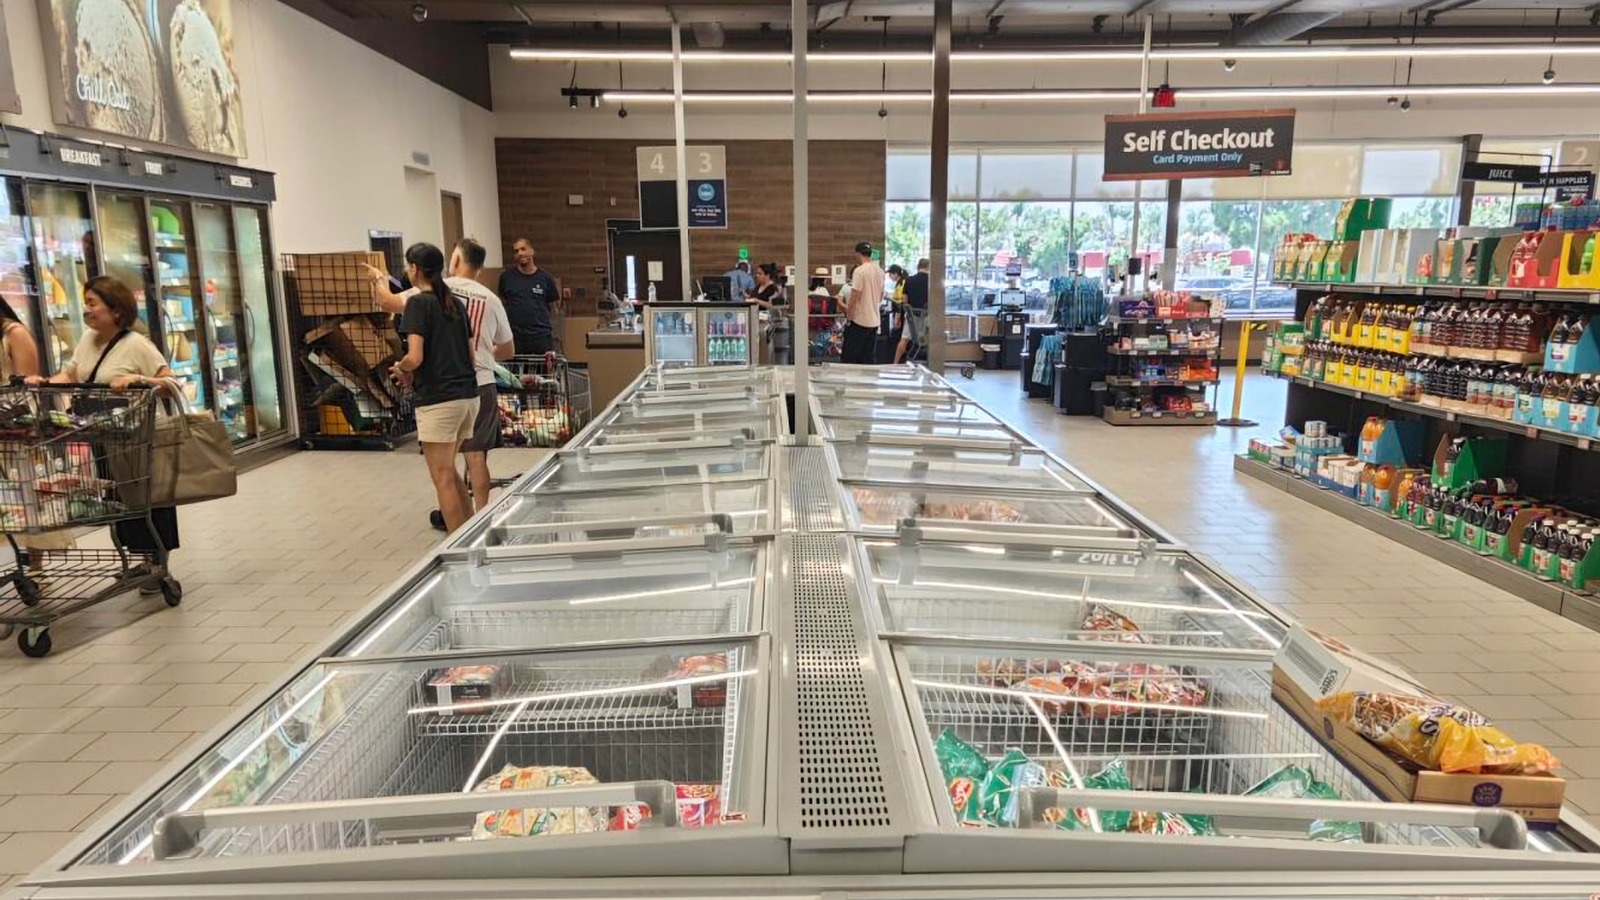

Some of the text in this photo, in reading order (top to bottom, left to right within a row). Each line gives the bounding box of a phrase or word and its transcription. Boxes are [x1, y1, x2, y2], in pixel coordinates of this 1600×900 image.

[77, 74, 106, 105] Chill
[1123, 128, 1275, 152] Self Checkout
[60, 148, 101, 167] BREAKFAST
[650, 152, 664, 174] 4
[699, 152, 713, 173] 3
[1153, 152, 1243, 165] Card Payment Only
[1573, 146, 1588, 166] 2
[1488, 169, 1514, 179] JUICE
[1555, 176, 1588, 185] SUPPLIES
